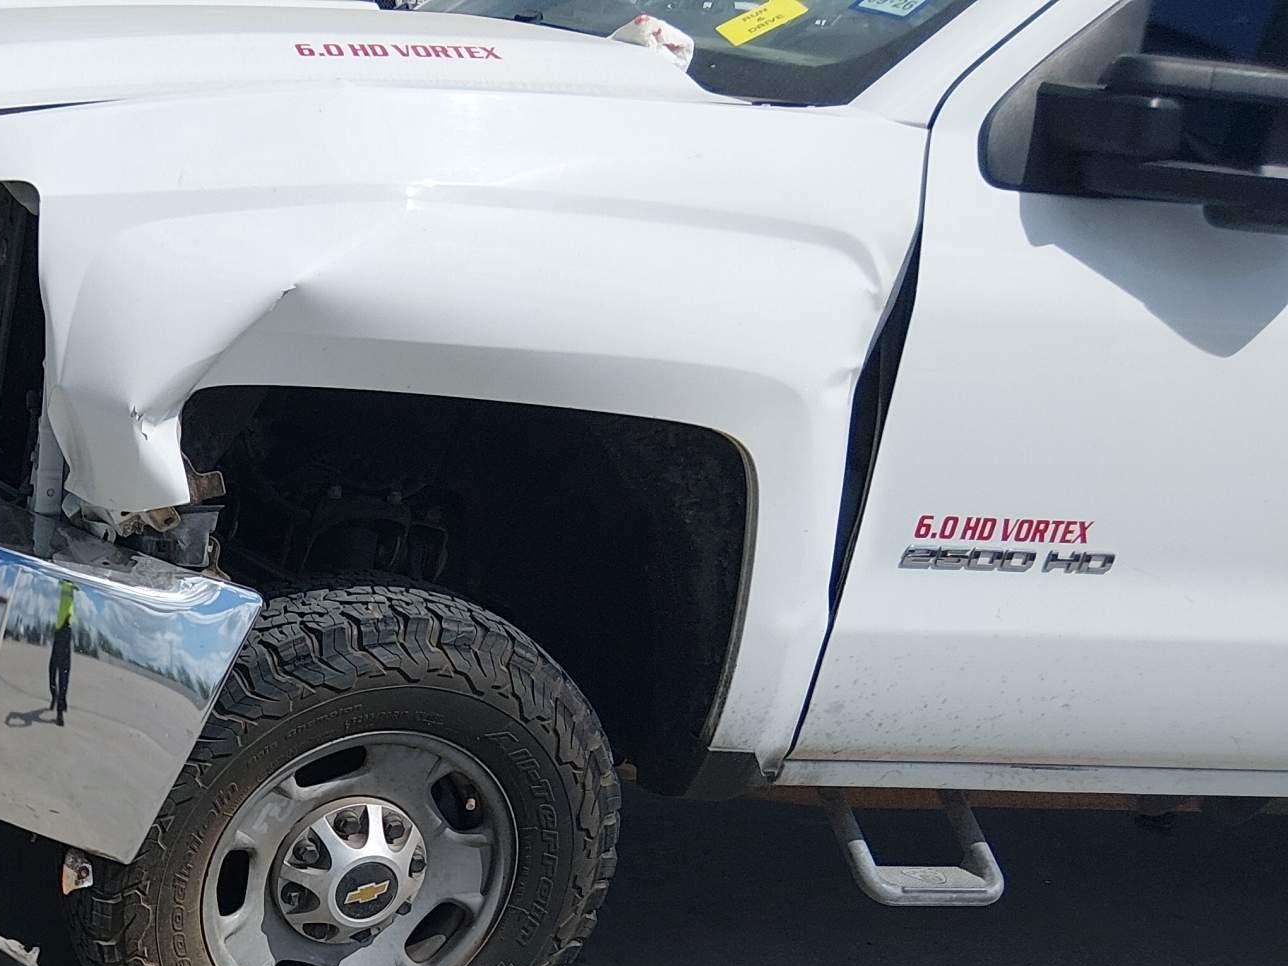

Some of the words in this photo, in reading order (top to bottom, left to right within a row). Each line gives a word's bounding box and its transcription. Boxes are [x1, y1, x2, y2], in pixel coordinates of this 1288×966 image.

[742, 7, 768, 22] RUN
[748, 14, 786, 34] DRIVE
[294, 43, 345, 57] 6.0
[347, 43, 390, 57] HD
[391, 44, 503, 60] VORTEX
[914, 514, 959, 540] 6.0
[960, 516, 997, 542] HD
[1000, 518, 1095, 545] VORTEX
[898, 544, 1037, 573] 2500
[1041, 549, 1116, 576] HD
